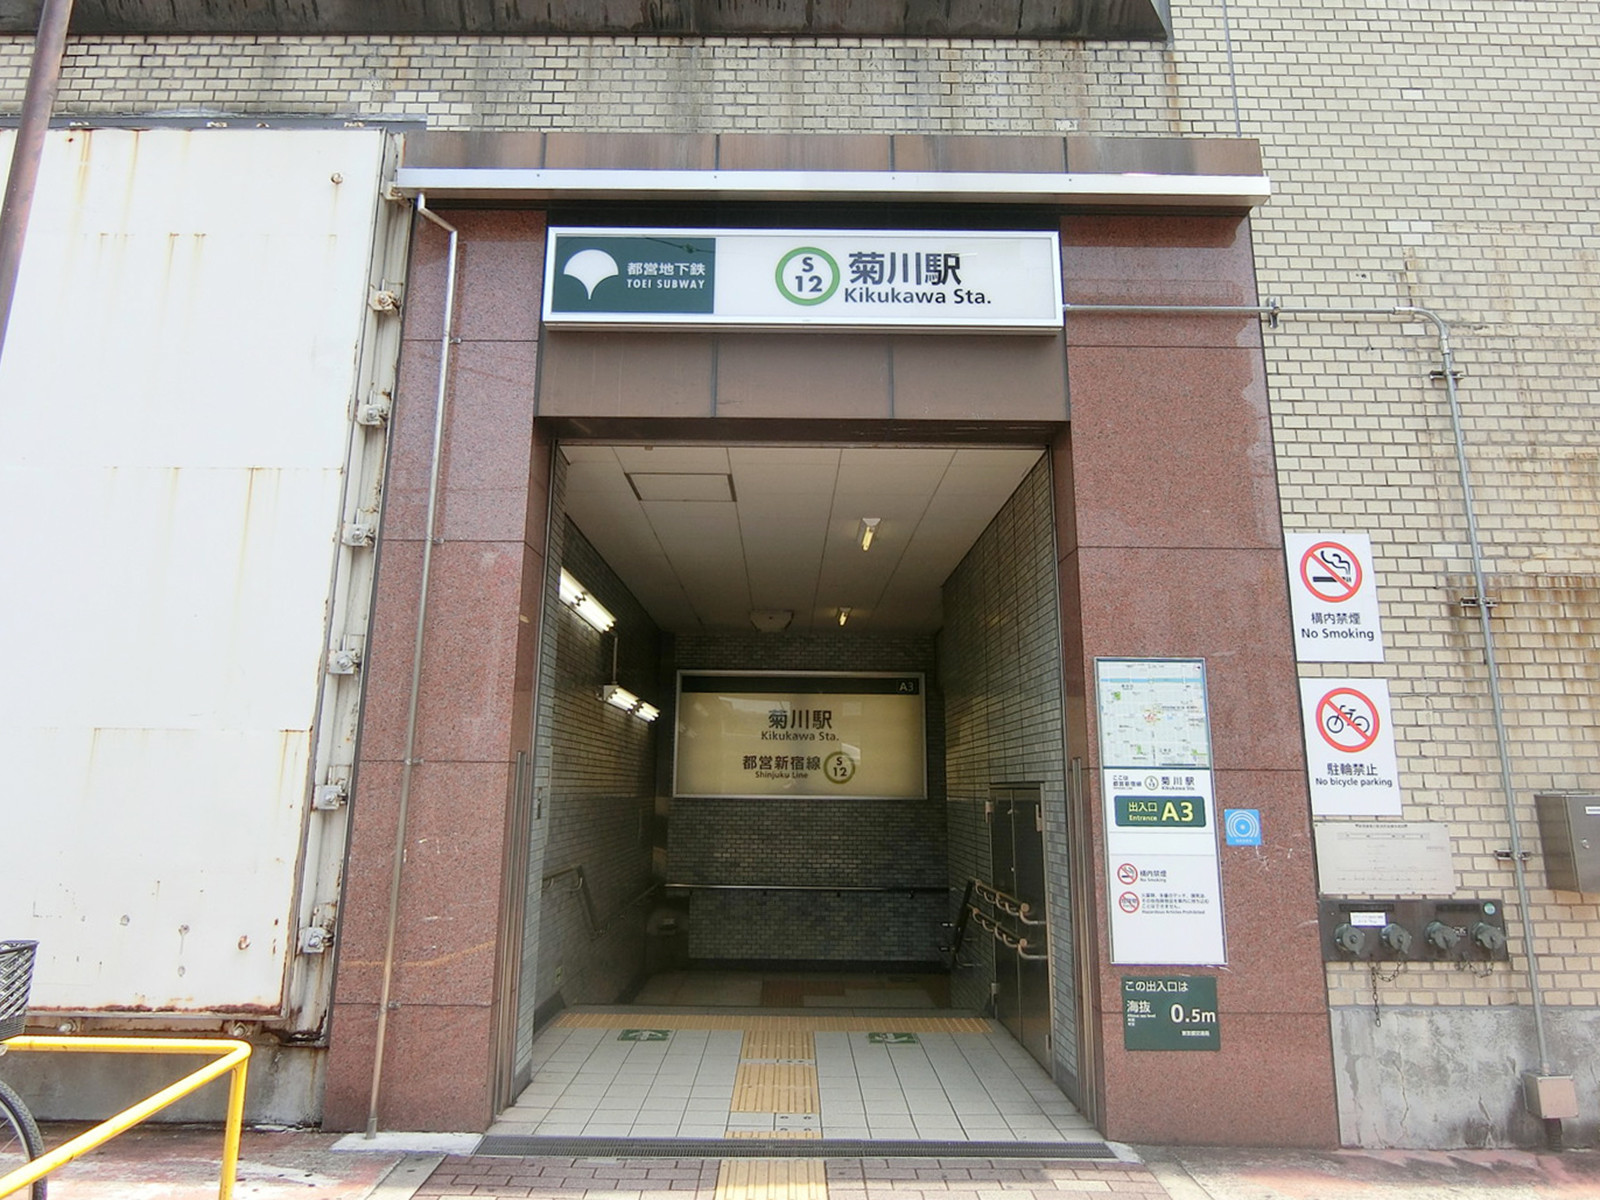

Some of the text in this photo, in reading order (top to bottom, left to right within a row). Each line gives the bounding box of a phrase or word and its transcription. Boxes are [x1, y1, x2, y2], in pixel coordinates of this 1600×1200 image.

[627, 262, 706, 276] 都営地下鉄
[802, 257, 814, 273] S
[849, 252, 962, 285] 菊川駅
[626, 279, 705, 289] TOEI SUBWAY
[795, 275, 823, 292] 12
[844, 287, 992, 304] Kikukawa Sta.
[1311, 612, 1361, 625] 構内禁煙
[1302, 628, 1374, 642] No Smoking
[899, 681, 914, 692] A3
[768, 709, 832, 730] 菊川駅
[761, 731, 840, 741] Kikukawa Sta.
[742, 755, 821, 771] 都営新宿線
[836, 757, 843, 766] S
[755, 771, 809, 780] Shinjuku Line
[832, 767, 848, 777] 12
[1327, 763, 1378, 776] 駐輪禁止
[1316, 777, 1393, 788] No bicycle parking
[1128, 802, 1158, 812] 出入口
[1161, 801, 1194, 822] A3
[1125, 981, 1189, 992] この出入口は
[1127, 1000, 1151, 1013] 海抜
[1170, 1004, 1216, 1023] 0.5m
